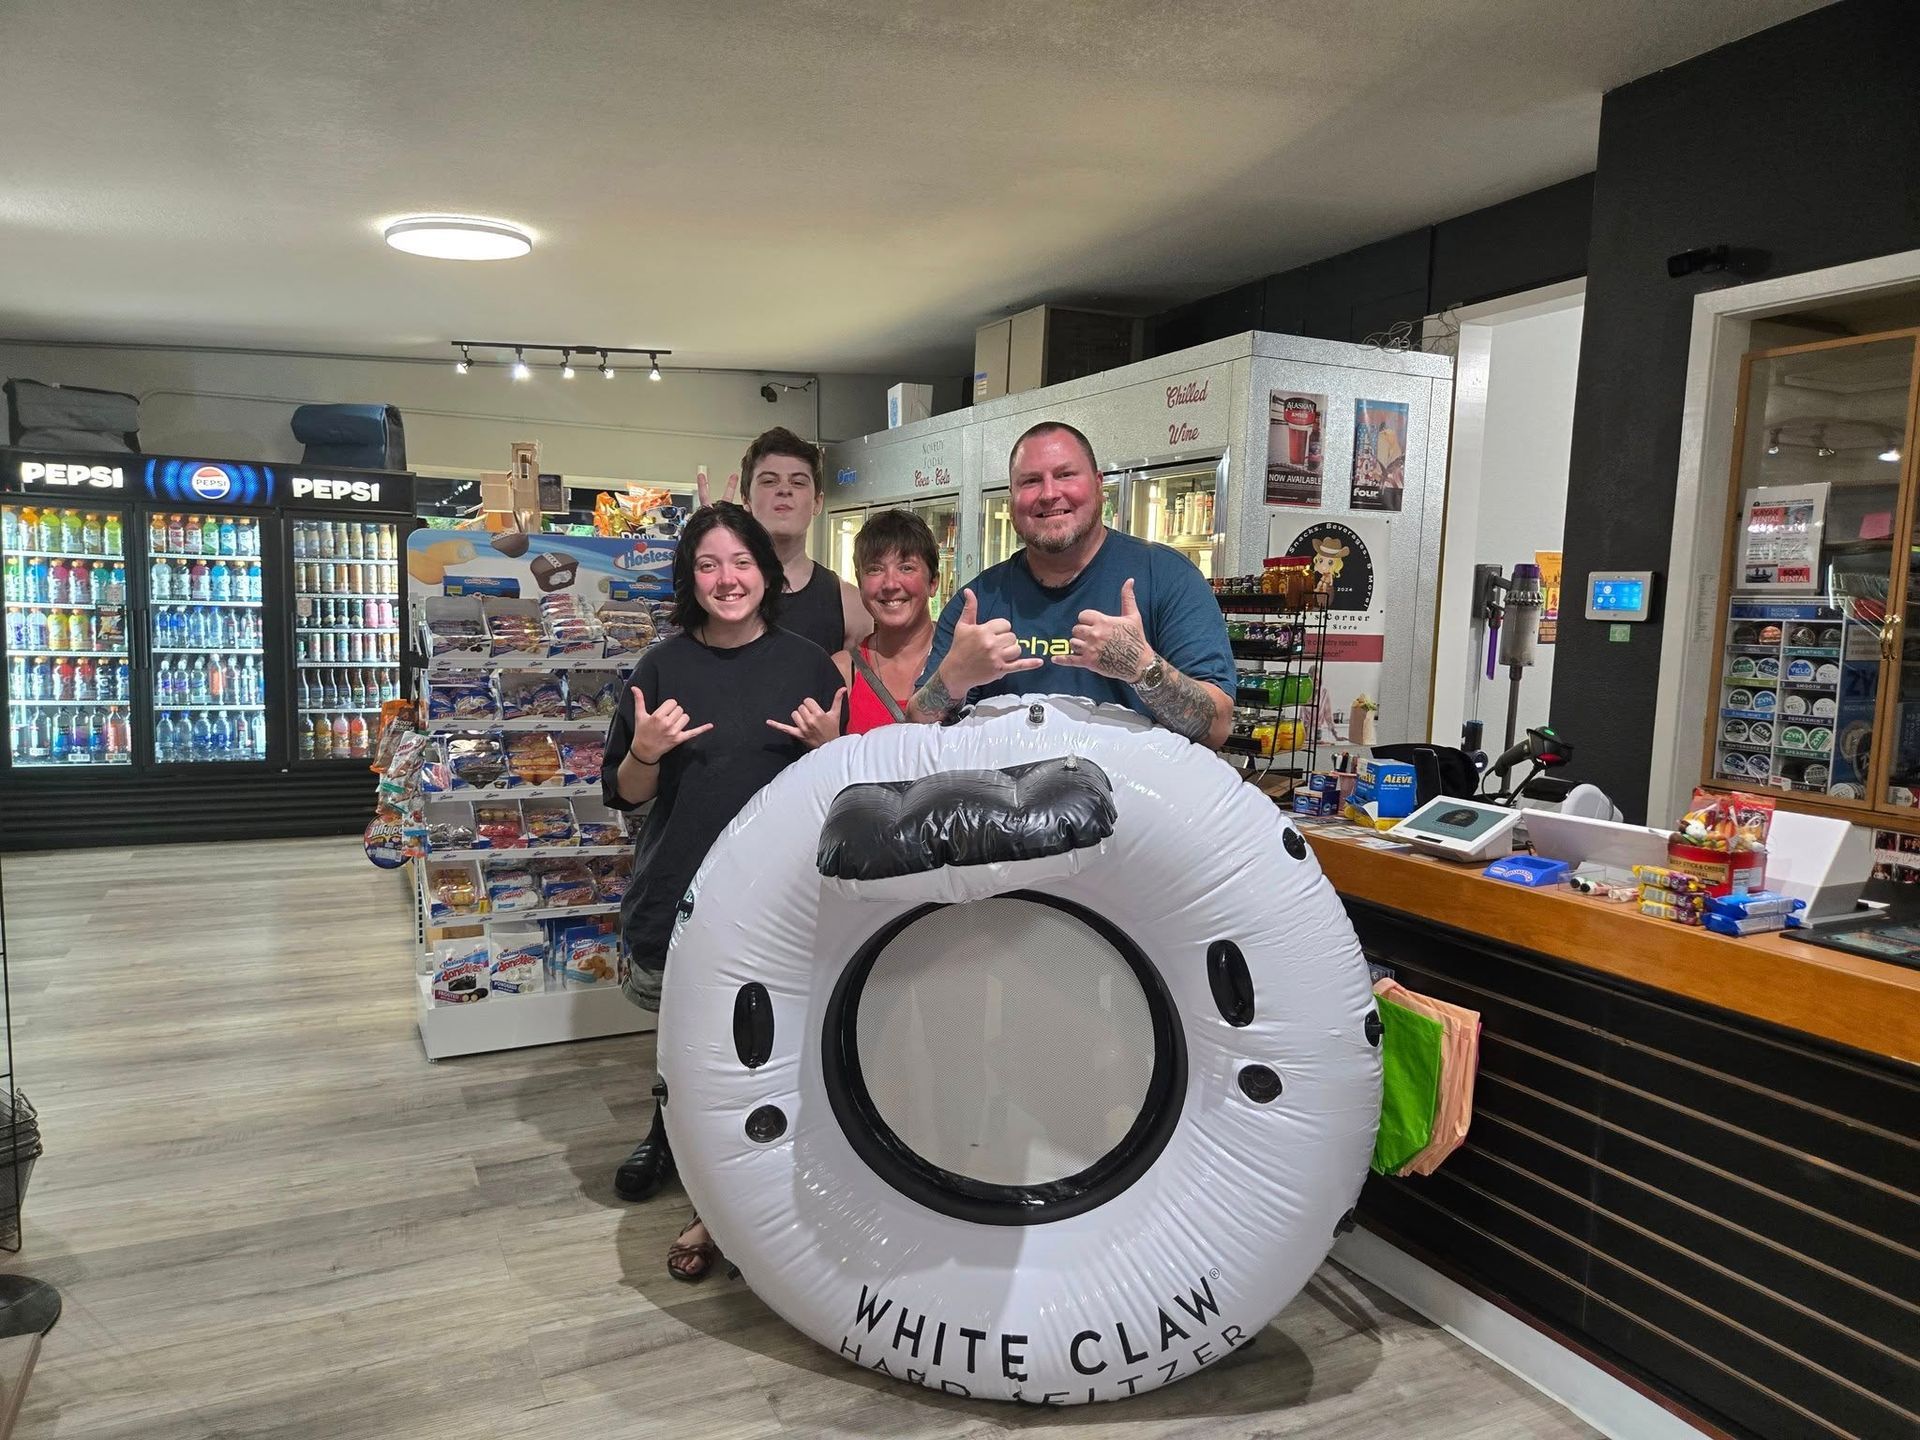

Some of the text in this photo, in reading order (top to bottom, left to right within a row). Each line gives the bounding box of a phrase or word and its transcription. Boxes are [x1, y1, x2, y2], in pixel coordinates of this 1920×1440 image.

[1166, 380, 1209, 408] Chilled
[1168, 423, 1200, 445] Wine
[21, 461, 124, 488] PEPSI
[195, 478, 227, 488] PEPSI
[1268, 474, 1322, 485] NOW AVAILABLE
[291, 477, 381, 502] PEPSI
[623, 550, 675, 569] Hostess
[1779, 575, 1808, 584] RENTAL
[1326, 612, 1372, 622] Corner
[1332, 623, 1358, 631] Store
[442, 963, 483, 982] donettes
[499, 955, 537, 972] donettes
[855, 1283, 1029, 1383] WHITE
